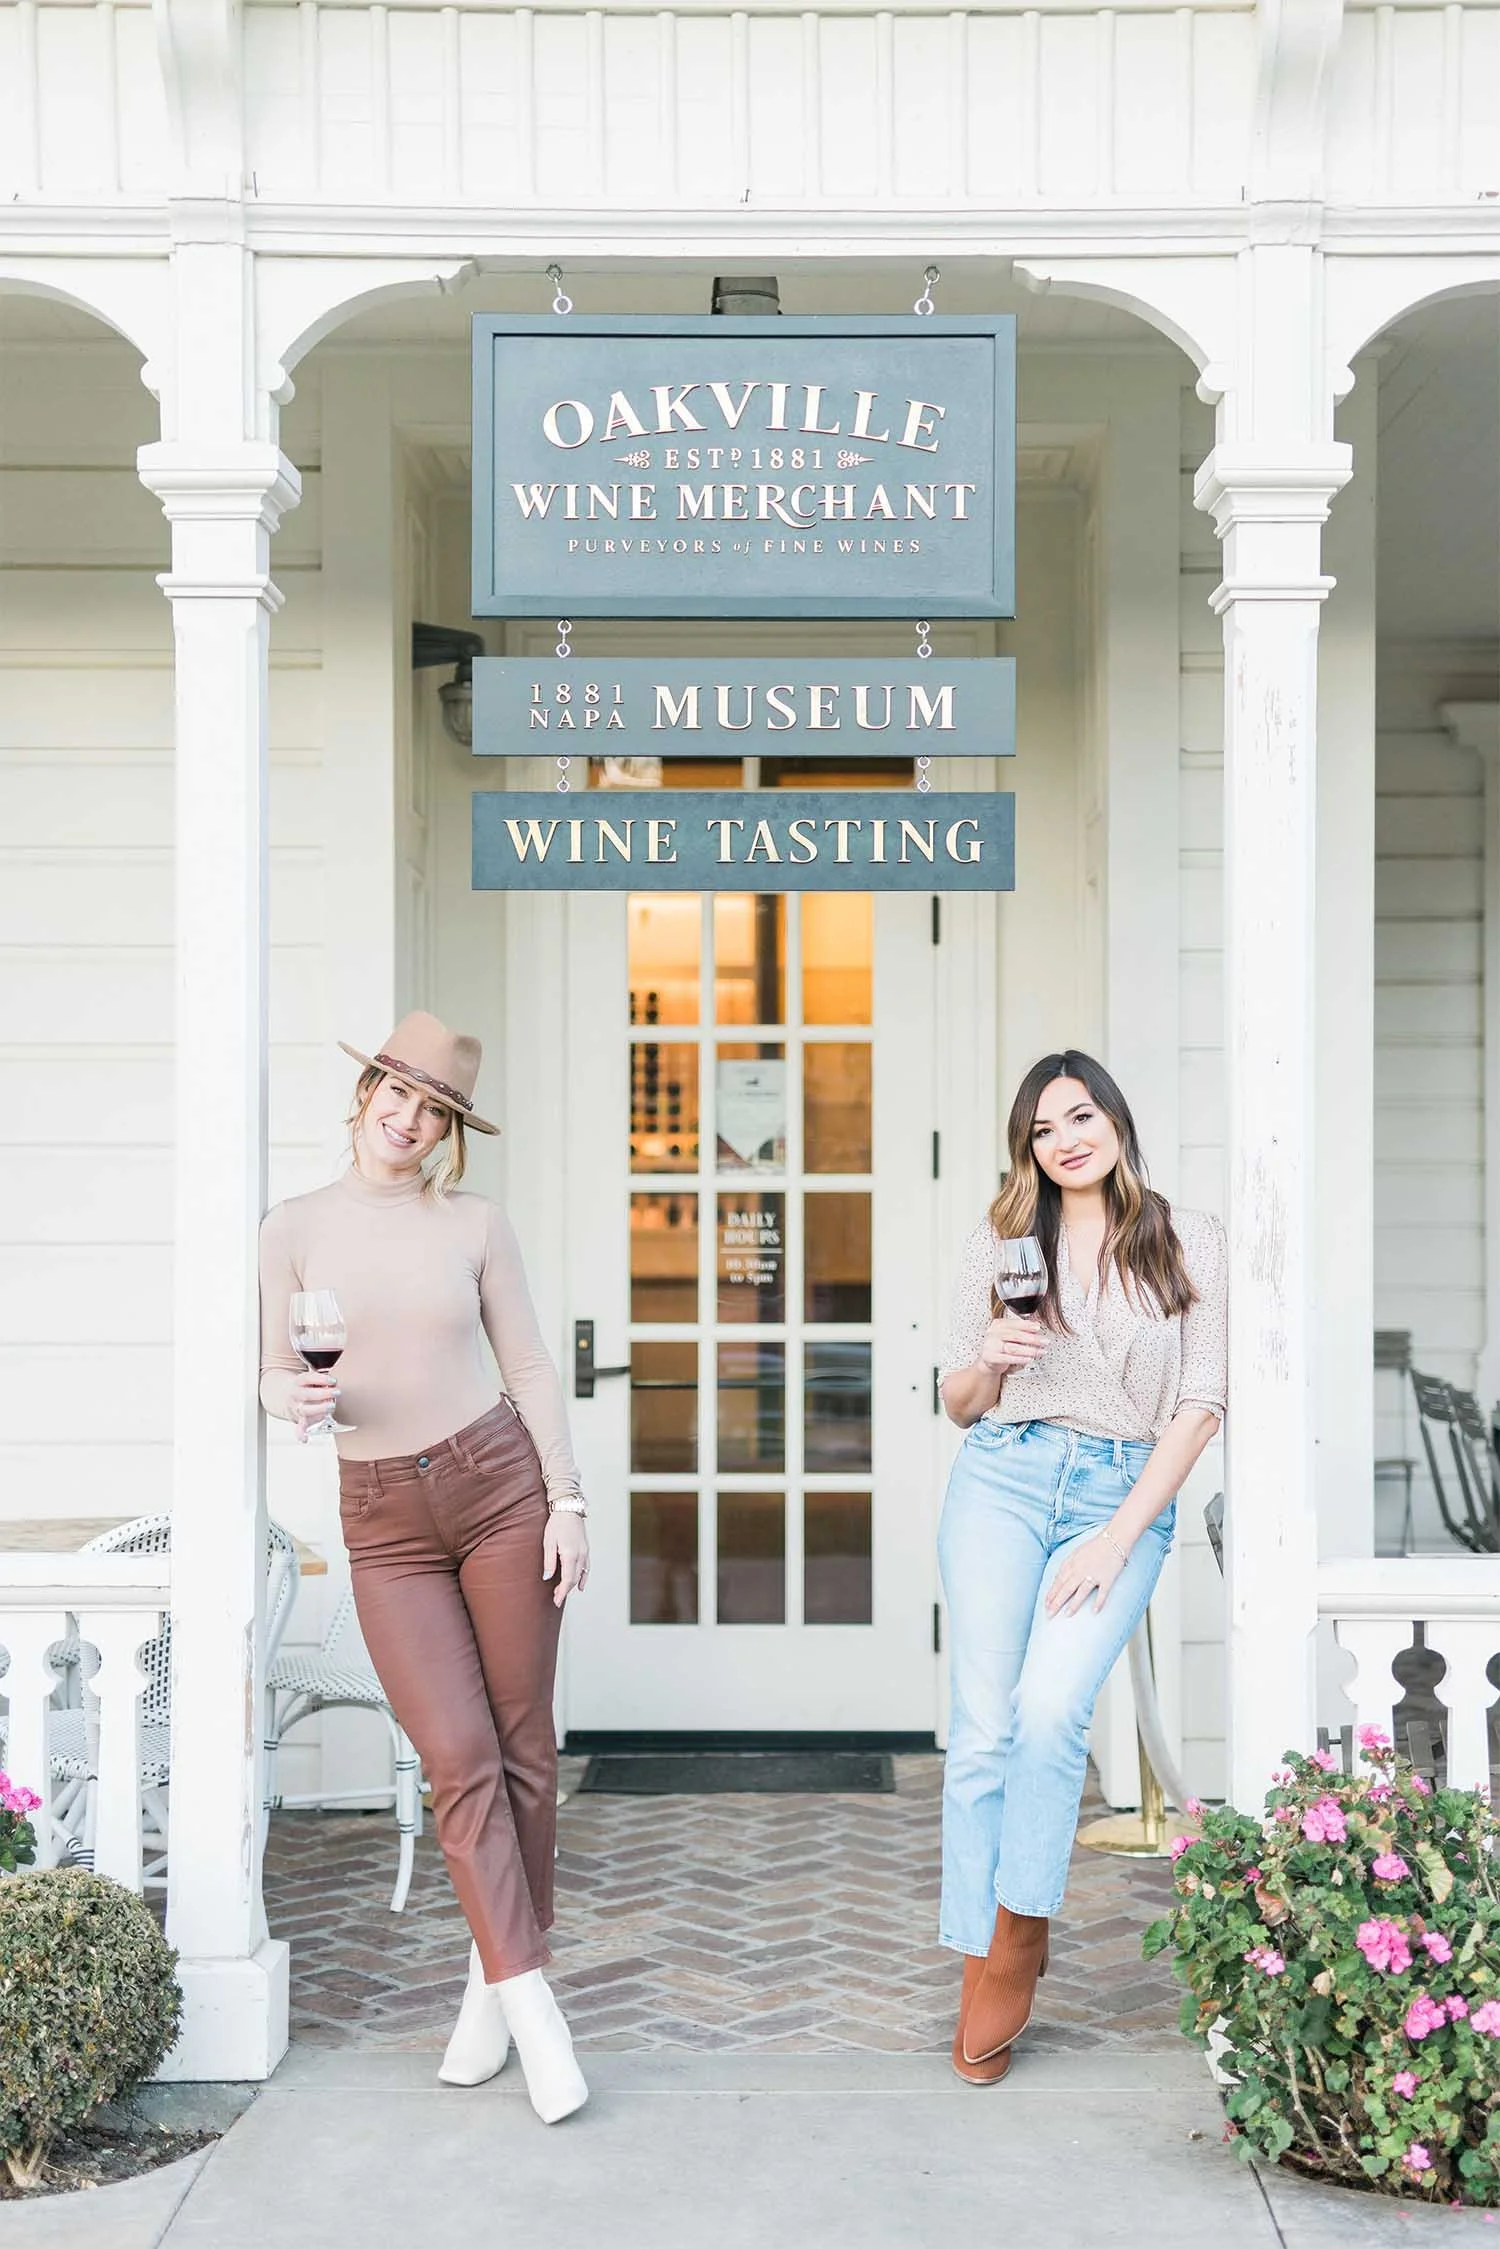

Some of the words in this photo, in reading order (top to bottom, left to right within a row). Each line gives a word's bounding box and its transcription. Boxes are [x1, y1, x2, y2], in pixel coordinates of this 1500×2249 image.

[543, 382, 946, 453] OAKVILLE
[751, 449, 824, 469] 1881
[511, 483, 657, 520] WINE
[677, 484, 976, 529] MERCHANT
[568, 539, 721, 554] PURVEYORS
[733, 539, 752, 556] of
[764, 539, 824, 554] FINE
[837, 539, 921, 554] WINES
[530, 683, 625, 704] 1881
[650, 684, 957, 730] MUSEUM
[528, 708, 625, 729] NAPA
[504, 819, 677, 863] WINE
[707, 819, 984, 864] TASTING
[727, 1212, 776, 1228] DAILY
[724, 1229, 780, 1245] HOURS
